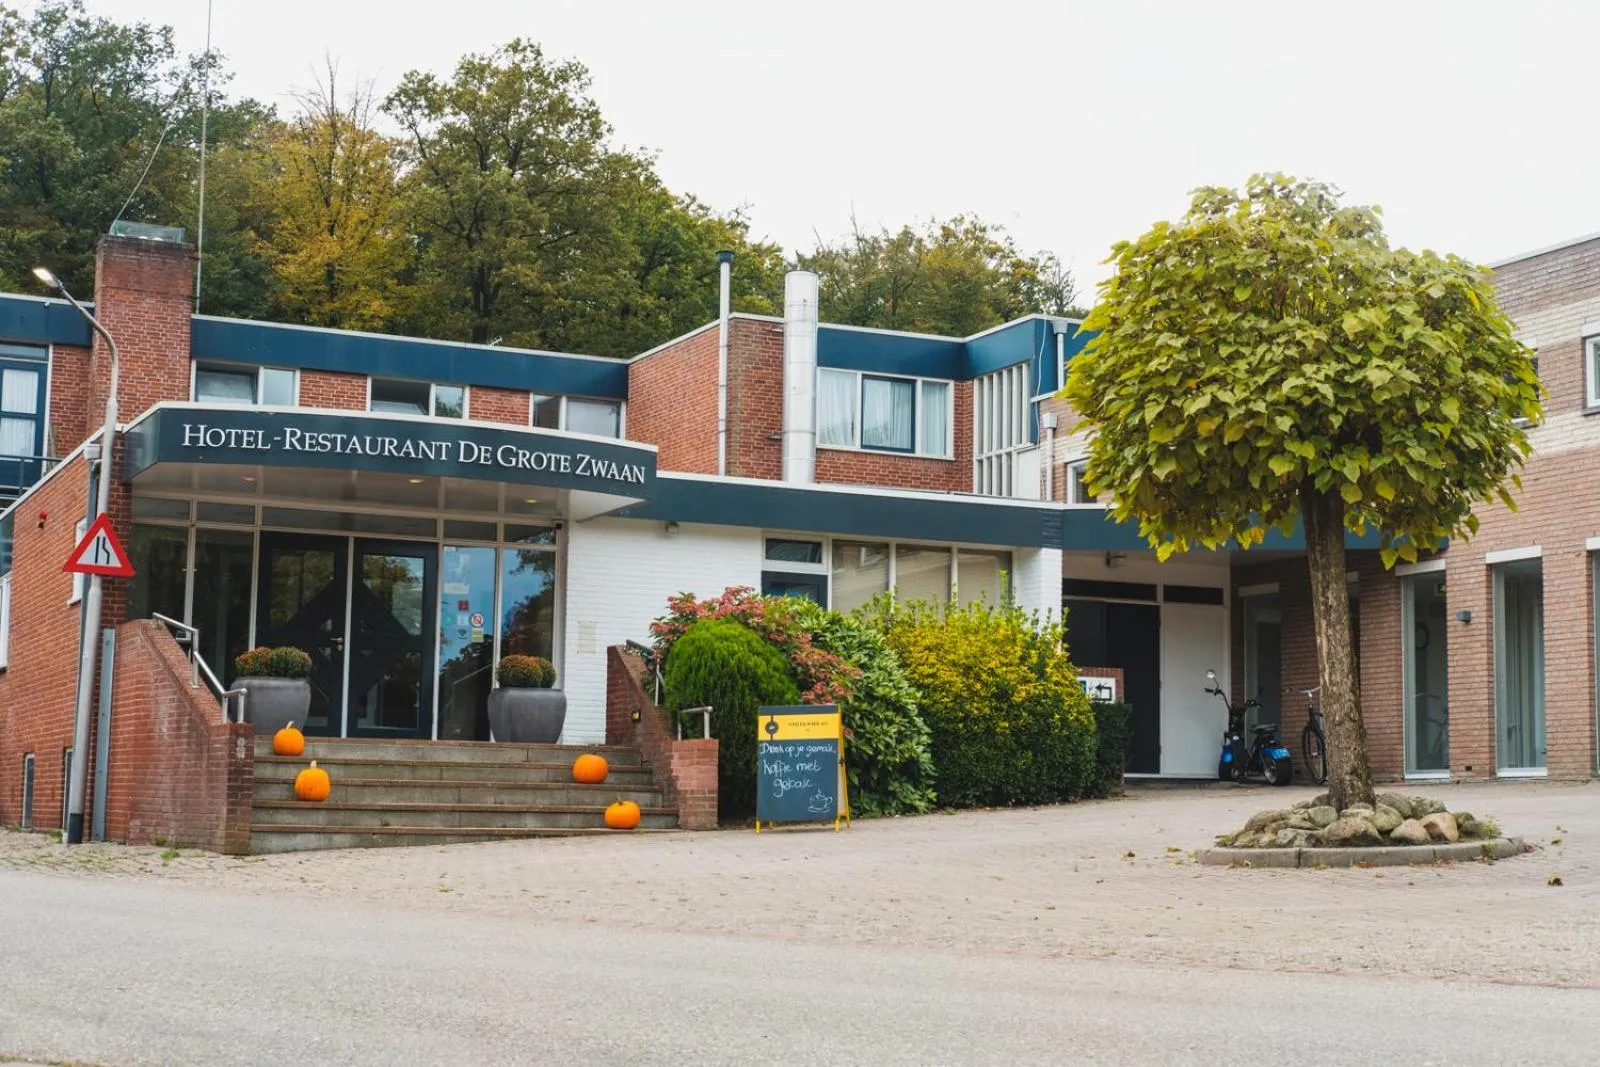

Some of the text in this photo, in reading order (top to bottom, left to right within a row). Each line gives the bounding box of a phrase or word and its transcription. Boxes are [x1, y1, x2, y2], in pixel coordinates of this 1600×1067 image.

[458, 440, 492, 464] DE
[497, 445, 571, 473] GROTE
[575, 453, 645, 484] ZWAAN
[785, 744, 795, 757] op
[795, 745, 804, 758] je
[796, 760, 822, 772] met
[773, 778, 812, 798] gebak
